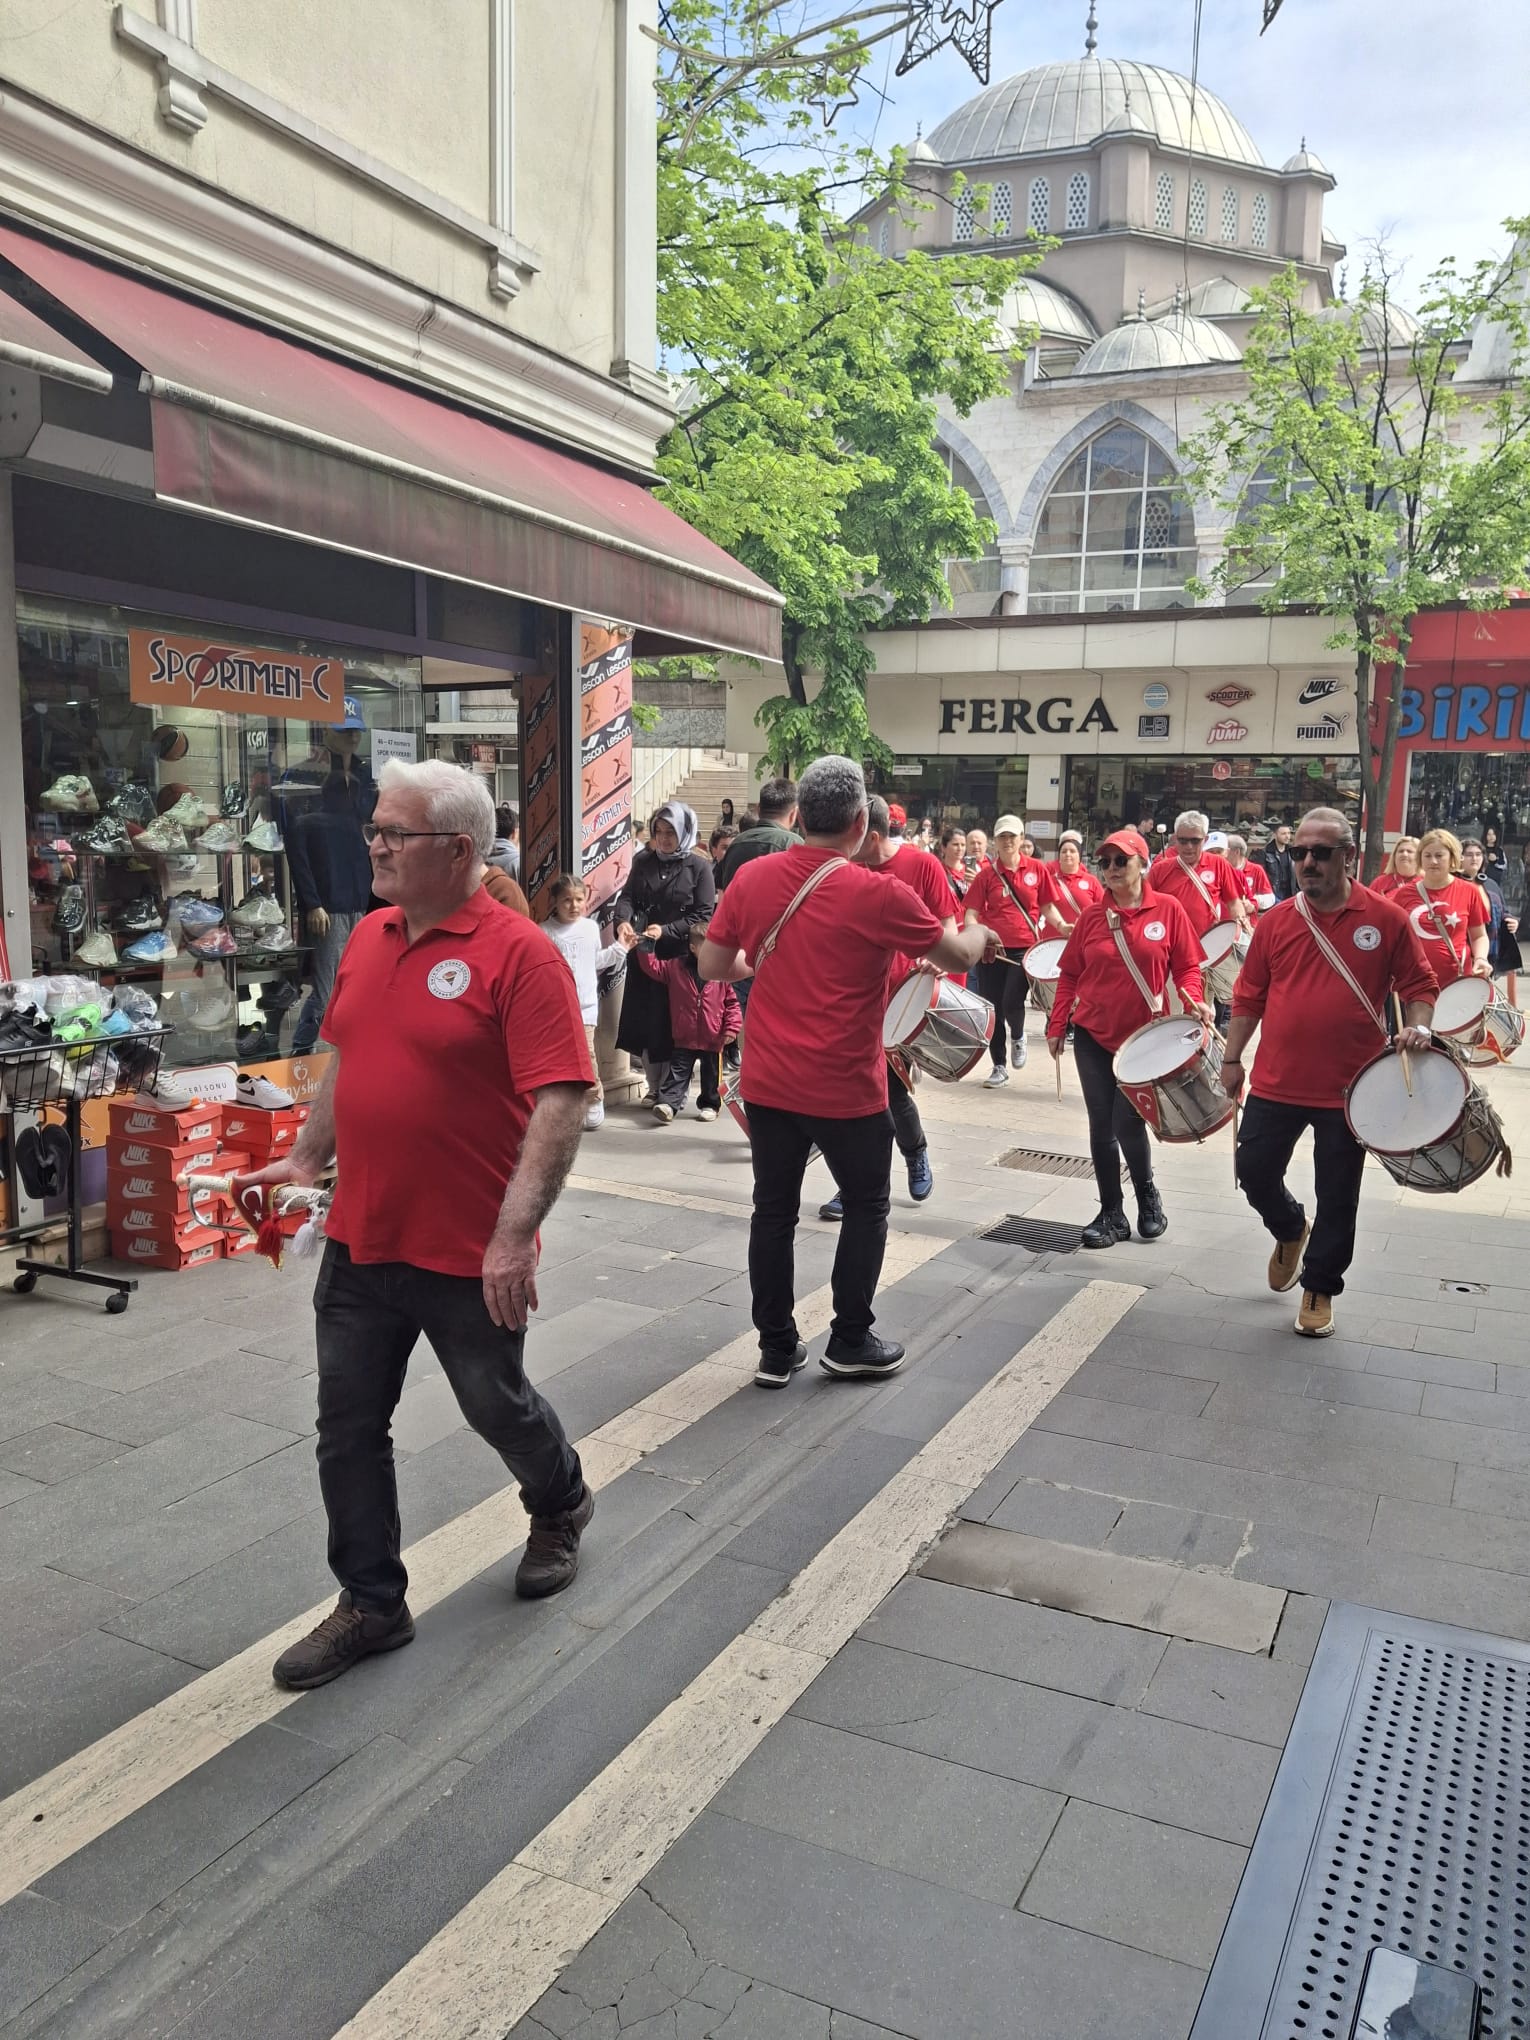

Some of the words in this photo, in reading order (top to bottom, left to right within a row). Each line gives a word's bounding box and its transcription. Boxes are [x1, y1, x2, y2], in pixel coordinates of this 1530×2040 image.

[149, 639, 330, 703] SPORTMEN-C
[1306, 680, 1337, 694] NIKE
[1209, 690, 1250, 702] SCOOTER
[938, 697, 1119, 734] FERGA
[1206, 728, 1247, 745] JUMP
[1297, 726, 1336, 739] PUMA
[480, 752, 494, 761] WC
[204, 1082, 227, 1092] SONU
[132, 1112, 157, 1129] NIKE
[127, 1144, 151, 1161] NIKE
[129, 1177, 154, 1194] NIKE
[129, 1209, 154, 1226] NIKE
[134, 1237, 159, 1254] NIKE
